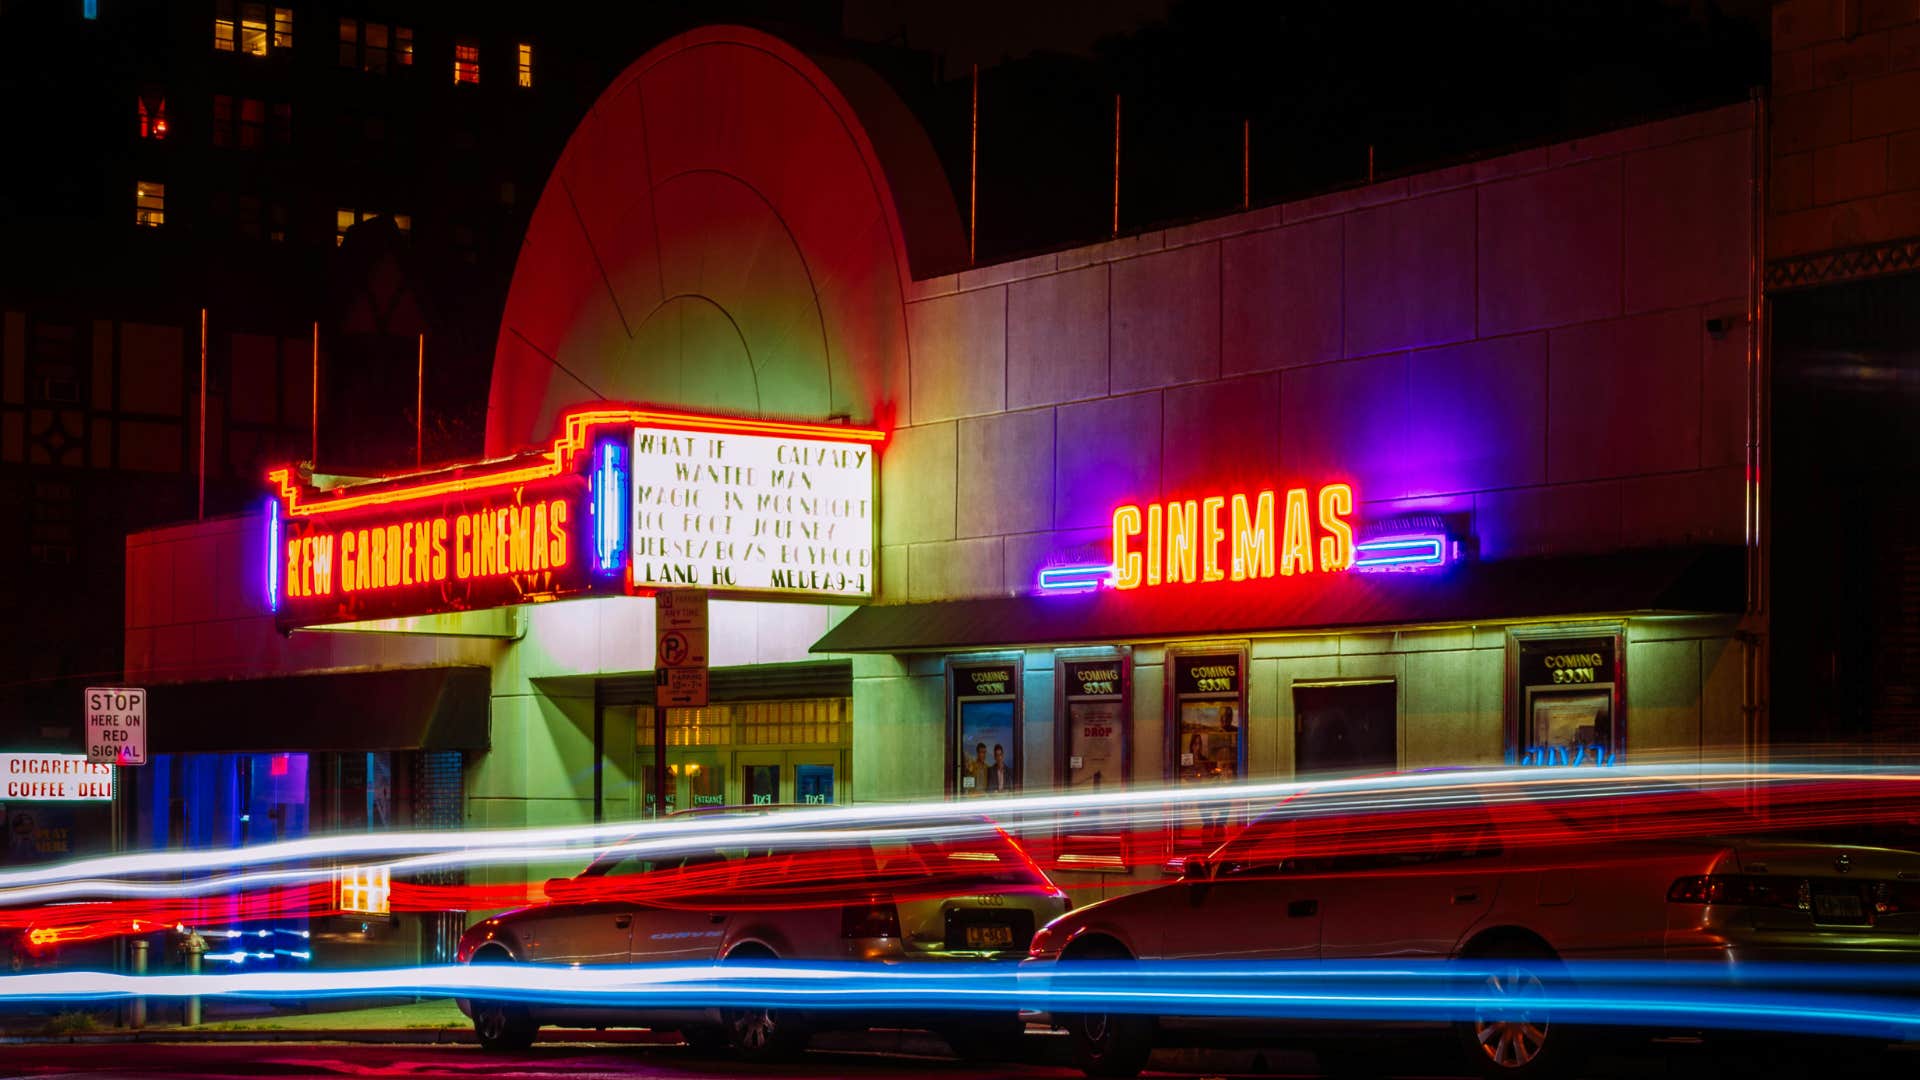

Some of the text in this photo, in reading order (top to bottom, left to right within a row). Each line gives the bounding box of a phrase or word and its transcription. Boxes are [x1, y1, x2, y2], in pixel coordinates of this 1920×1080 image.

[639, 434, 867, 469] WHAT IF CALVARY
[676, 462, 813, 490] WANTED MAN
[638, 485, 868, 518] MAGIC IN MOONLIGHT
[683, 513, 733, 534] FOOT
[1112, 483, 1353, 590] CINEMAS
[287, 500, 567, 597] KEW GARDENS CINEMAS
[781, 544, 870, 567] BOYHOOD
[645, 563, 699, 584] LAND
[712, 565, 737, 586] HO
[1544, 653, 1603, 668] COMING
[971, 671, 1010, 682] COMING
[1078, 670, 1118, 682] COMING
[1191, 665, 1235, 678] COMING
[1552, 668, 1594, 684] SOON
[976, 682, 1006, 694] SOON
[1083, 682, 1113, 694] SOON
[1197, 678, 1231, 691] SOON
[90, 694, 141, 711] STOP
[90, 714, 141, 727] HERE ON
[103, 730, 128, 742] RED
[1084, 727, 1113, 737] DROP
[91, 745, 140, 758] SIGNAL
[10, 758, 110, 776] CIGARETTES
[8, 781, 111, 798] COFFEE DELI
